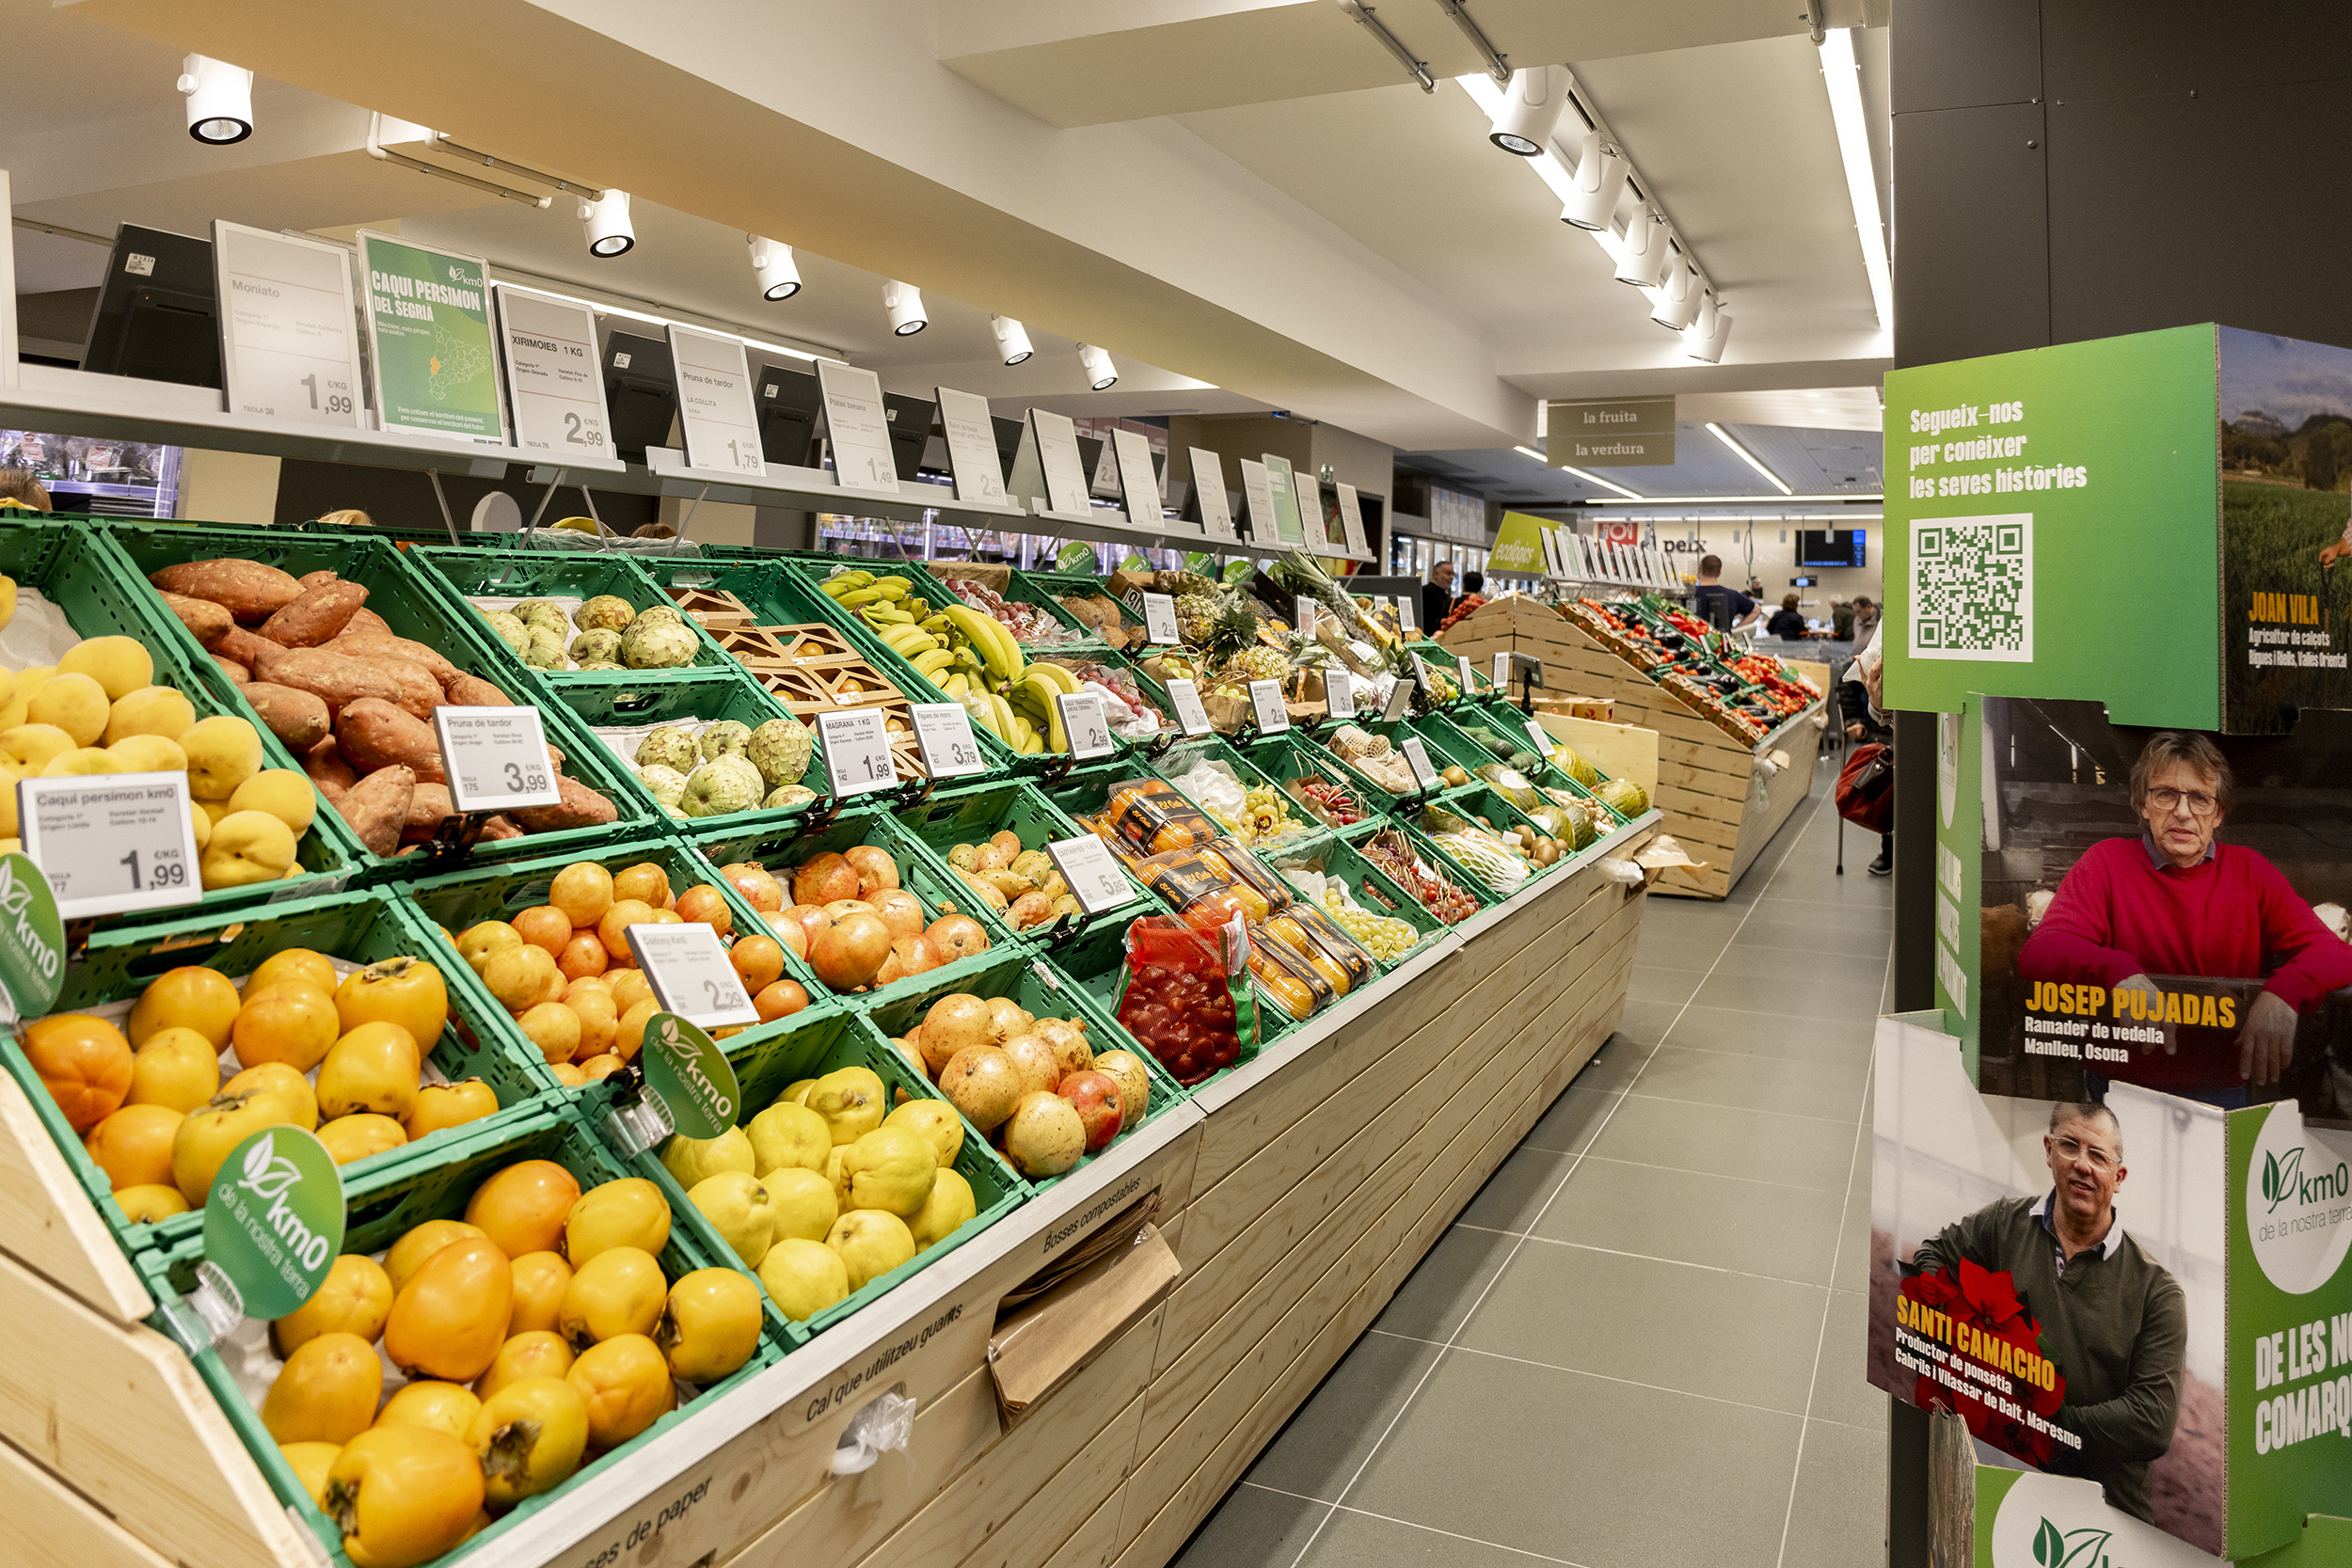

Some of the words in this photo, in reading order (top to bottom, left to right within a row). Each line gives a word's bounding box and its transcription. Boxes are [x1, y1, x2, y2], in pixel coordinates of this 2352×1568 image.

[231, 279, 280, 298] Moniato
[371, 270, 414, 299] CAQUI
[415, 278, 482, 311] PERSIMON
[373, 295, 394, 315] DEL
[394, 300, 435, 323] SEGRIÀ
[318, 325, 342, 334] California
[512, 335, 558, 353] XIRIMOIES
[570, 347, 583, 356] KG
[683, 372, 704, 384] Pruna
[704, 376, 713, 385] de
[714, 377, 734, 389] tardor
[243, 404, 264, 414] TECLA
[264, 407, 275, 416] 38
[687, 396, 695, 404] LA
[695, 397, 718, 407] COLLITA
[829, 398, 847, 408] Plàtan
[848, 401, 866, 412] banana
[1583, 412, 1597, 424] la
[1599, 411, 1637, 423] fruita
[1575, 444, 1588, 456] la
[1591, 443, 1645, 455] verdura
[1910, 444, 1940, 471] per
[1944, 435, 2027, 463] conèixer
[1909, 475, 1935, 499] les
[1939, 473, 1992, 498] seves
[1995, 463, 2088, 493] històries
[1071, 547, 1089, 565] km0
[1195, 553, 1210, 571] km0
[1495, 540, 1534, 568] ecològics
[1235, 564, 1252, 579] km0
[2249, 591, 2287, 623] JOAN
[2289, 594, 2320, 626] VILA
[2249, 626, 2290, 647] Agricultor
[2291, 629, 2301, 645] de
[2301, 630, 2330, 650] calçots
[2318, 652, 2348, 669] Oriental
[447, 719, 472, 728] Pruna
[474, 719, 485, 727] de
[486, 719, 512, 727] tardor
[825, 721, 854, 731] MAGRANA
[857, 719, 862, 727] 1
[862, 718, 871, 726] KG
[917, 712, 933, 721] Figues
[37, 793, 78, 808] Caqui
[81, 789, 144, 808] persimon
[147, 787, 175, 800] km0
[464, 783, 479, 791] 175
[154, 848, 181, 860] €/KG
[1057, 846, 1085, 857] CASTANYES
[15, 908, 58, 979] km0
[2025, 981, 2106, 1017] JOSEP
[2112, 987, 2236, 1029] PUJADAS
[2025, 1016, 2090, 1037] Ramader
[2091, 1022, 2109, 1039] de
[2112, 1024, 2165, 1045] vedella
[2025, 1037, 2083, 1061] Manlleu,
[2085, 1043, 2129, 1063] Osona
[649, 1035, 664, 1053] de
[663, 1051, 674, 1067] la
[673, 1065, 703, 1105] nostra
[702, 1101, 724, 1134] terra
[686, 1057, 734, 1117] km0
[2299, 1162, 2348, 1206] km0
[1043, 1218, 1079, 1254] Bosses
[1080, 1177, 1141, 1228] compostables
[2259, 1222, 2276, 1243] de
[2278, 1218, 2288, 1238] la
[2290, 1212, 2326, 1234] nostra
[2328, 1205, 2352, 1225] terra
[218, 1182, 238, 1210] de
[234, 1197, 249, 1224] la
[245, 1217, 284, 1268] nostra
[279, 1258, 311, 1301] terra
[265, 1190, 330, 1273] km0
[1896, 1294, 1953, 1347] SANTI
[1957, 1322, 2056, 1392] CAMACHO
[2255, 1331, 2284, 1391] DE
[2288, 1319, 2328, 1382] LES
[2331, 1311, 2352, 1368] N
[806, 1387, 834, 1422] Cal
[834, 1371, 863, 1405] que
[866, 1334, 918, 1382] utilitzeu
[919, 1304, 963, 1349] guants
[1895, 1326, 1949, 1364] Productor
[1949, 1353, 1963, 1372] de
[1964, 1360, 2012, 1396] ponsètia
[1895, 1346, 1931, 1378] Cabrils
[1931, 1366, 1937, 1381] i
[1937, 1367, 1983, 1402] Vilassar
[1983, 1389, 1998, 1410] de
[1998, 1397, 2026, 1426] Dalt,
[2026, 1409, 2083, 1450] Maresme
[2256, 1373, 2352, 1455] COMARQ
[626, 1520, 652, 1551] de
[657, 1476, 712, 1536] paper
